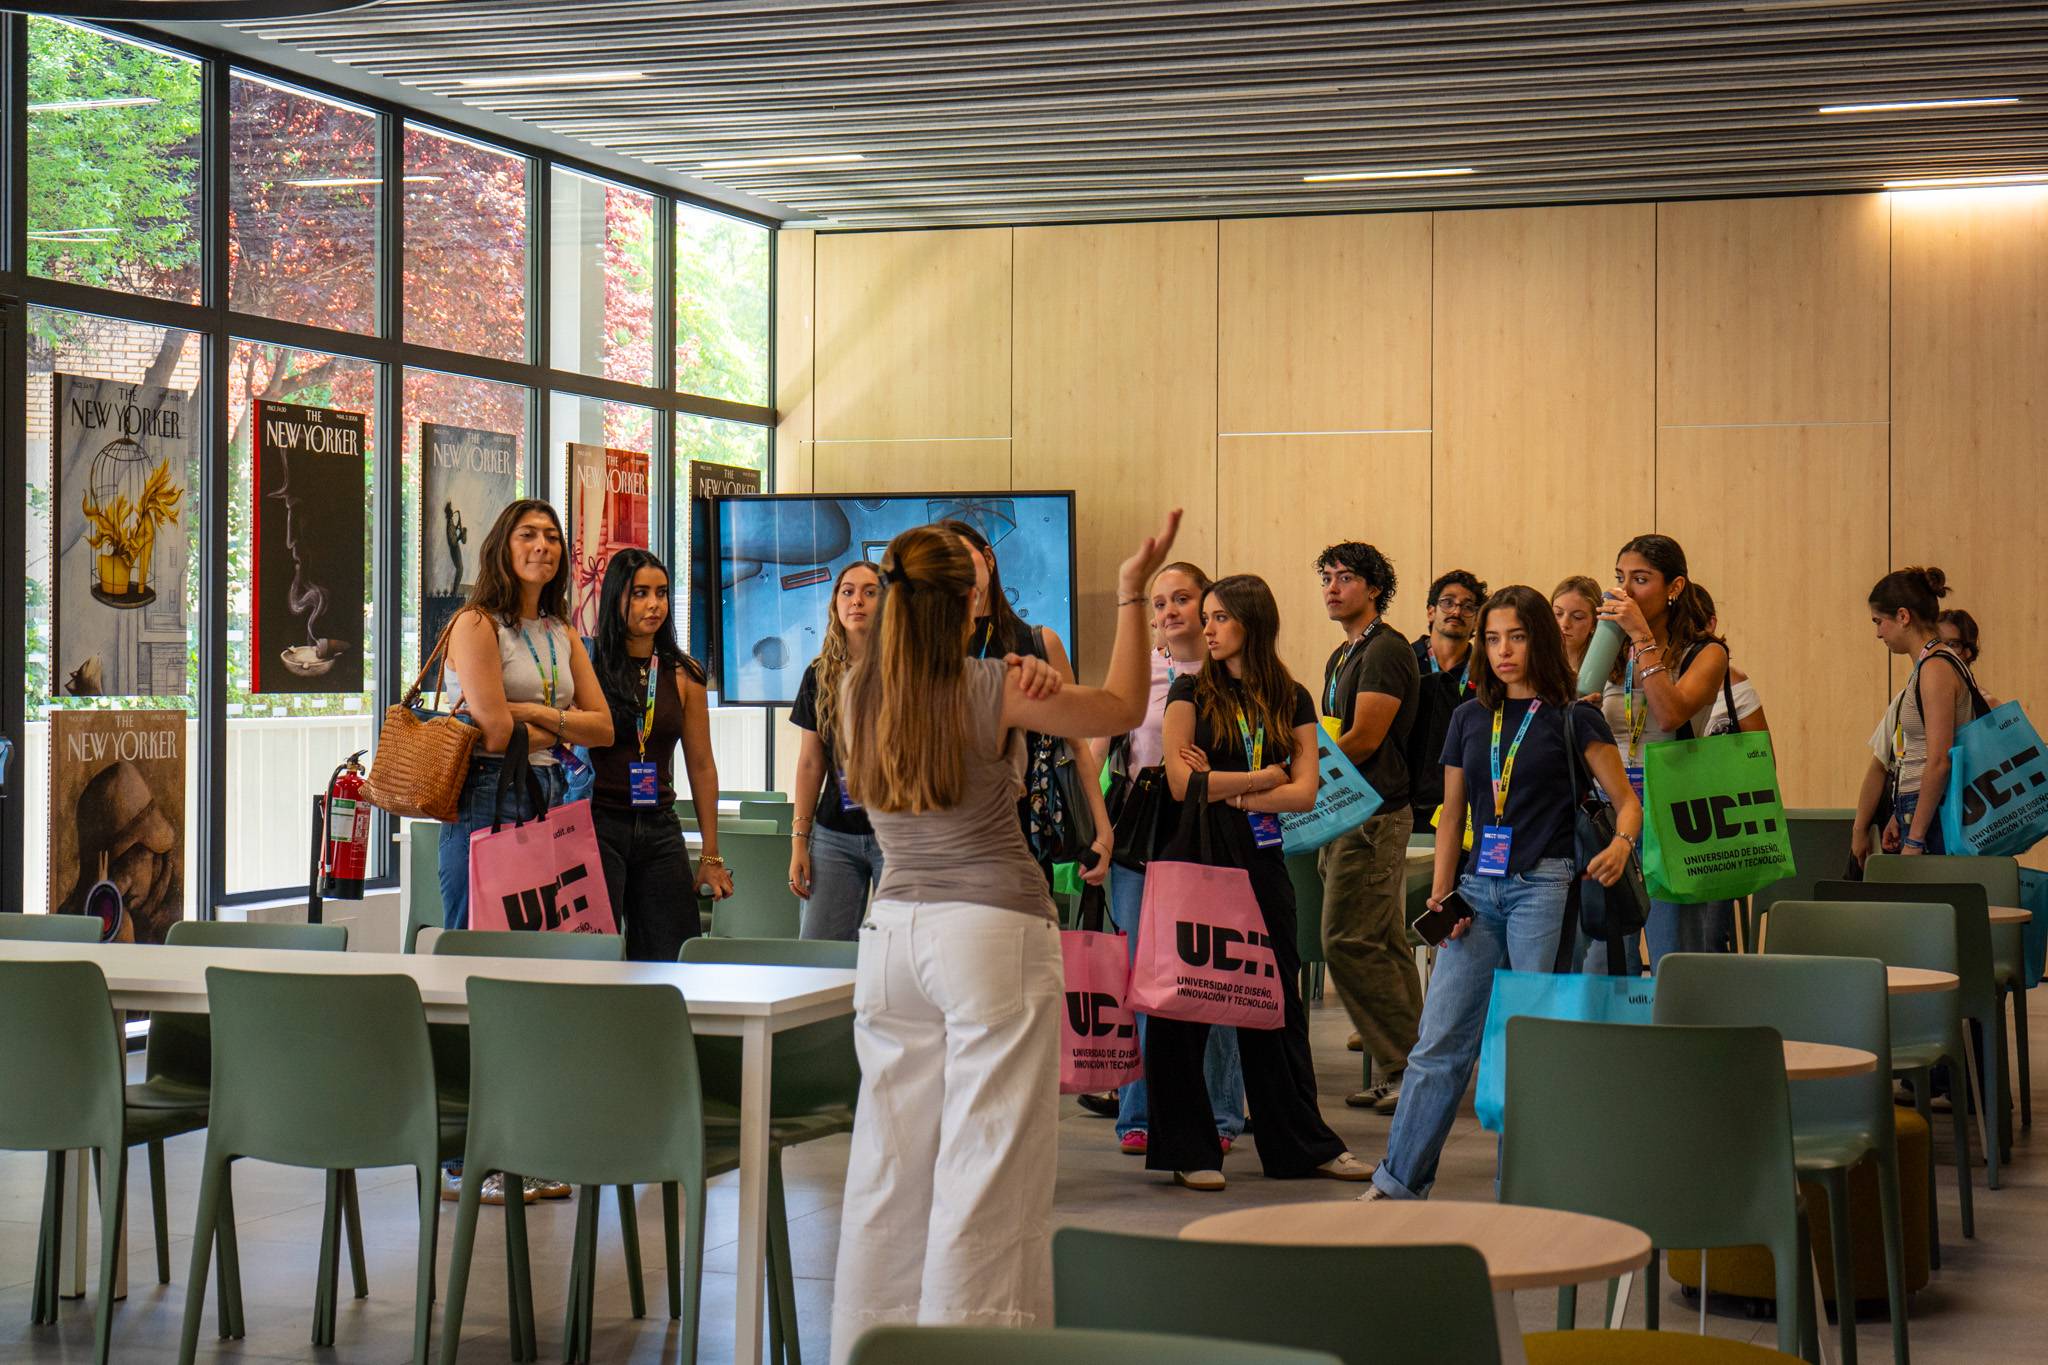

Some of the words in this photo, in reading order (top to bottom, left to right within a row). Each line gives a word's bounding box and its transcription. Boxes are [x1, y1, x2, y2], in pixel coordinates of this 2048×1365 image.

[118, 388, 137, 401] THE
[71, 398, 112, 430] NEW
[115, 403, 181, 439] YORKER
[306, 409, 322, 423] THE
[266, 420, 301, 448] NEW
[302, 424, 359, 456] YORKER
[466, 432, 480, 444] THE
[433, 442, 463, 469] NEW
[463, 445, 511, 474] YORKER
[606, 455, 619, 467] THE
[577, 464, 604, 489] NEW
[604, 468, 646, 496] YORKER
[724, 469, 734, 479] THE
[700, 477, 721, 499] NEW
[115, 715, 135, 728] THE
[67, 732, 109, 762] NEW
[111, 730, 178, 760] YORKER
[1318, 800, 1328, 808] DE
[1969, 811, 2018, 843] UNIVERSIDAD
[2017, 807, 2027, 816] DE
[1684, 849, 1740, 865] UNIVERSIDAD
[1741, 847, 1751, 856] DE
[1687, 860, 1737, 877] INNOVACIÓN
[1737, 860, 1743, 869] Y
[1177, 976, 1233, 993] UNIVERSIDAD
[1233, 985, 1243, 994] DE
[1244, 986, 1273, 1000] DISEÑO,
[1177, 987, 1227, 1003] INNOVACIÓN
[1226, 995, 1233, 1003] Y
[1234, 996, 1279, 1011] TECNOLOGÍA
[1107, 1048, 1117, 1058] DE
